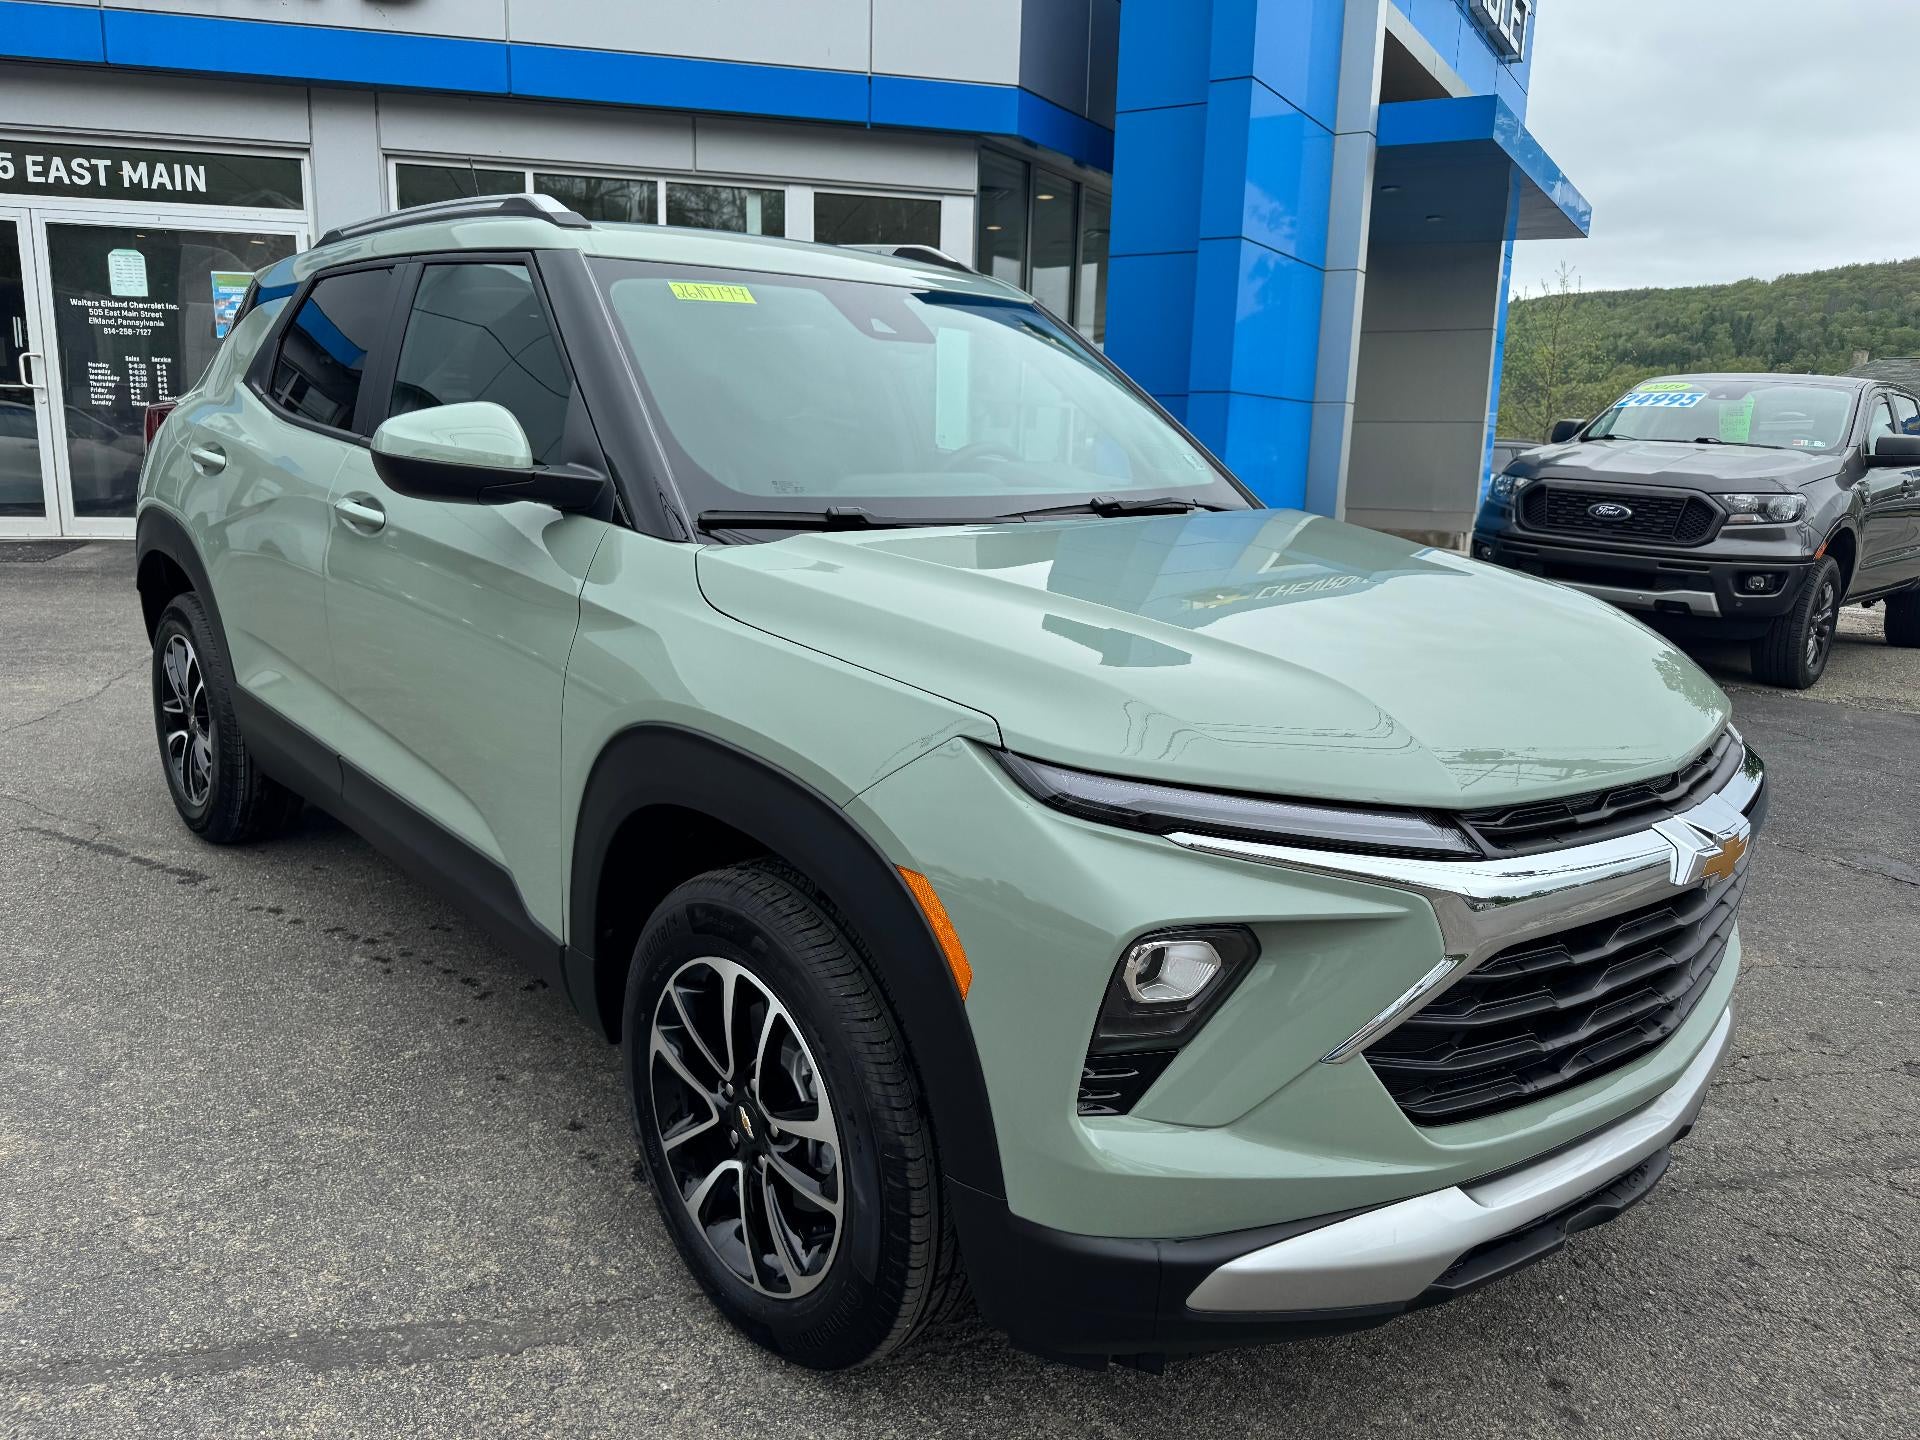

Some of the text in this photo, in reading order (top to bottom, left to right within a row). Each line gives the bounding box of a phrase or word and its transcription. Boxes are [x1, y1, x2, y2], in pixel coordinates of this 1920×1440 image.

[25, 154, 112, 187] EAST
[121, 160, 207, 193] MAIN
[69, 298, 180, 310] Walters Elkland Chevrolet Inc.
[88, 308, 163, 318] 505 East Main Street
[88, 317, 165, 327] Elkland, Pennsylvania
[88, 374, 121, 382] Wednesday
[1617, 393, 1703, 407] 24995
[1595, 505, 1621, 516] Ford
